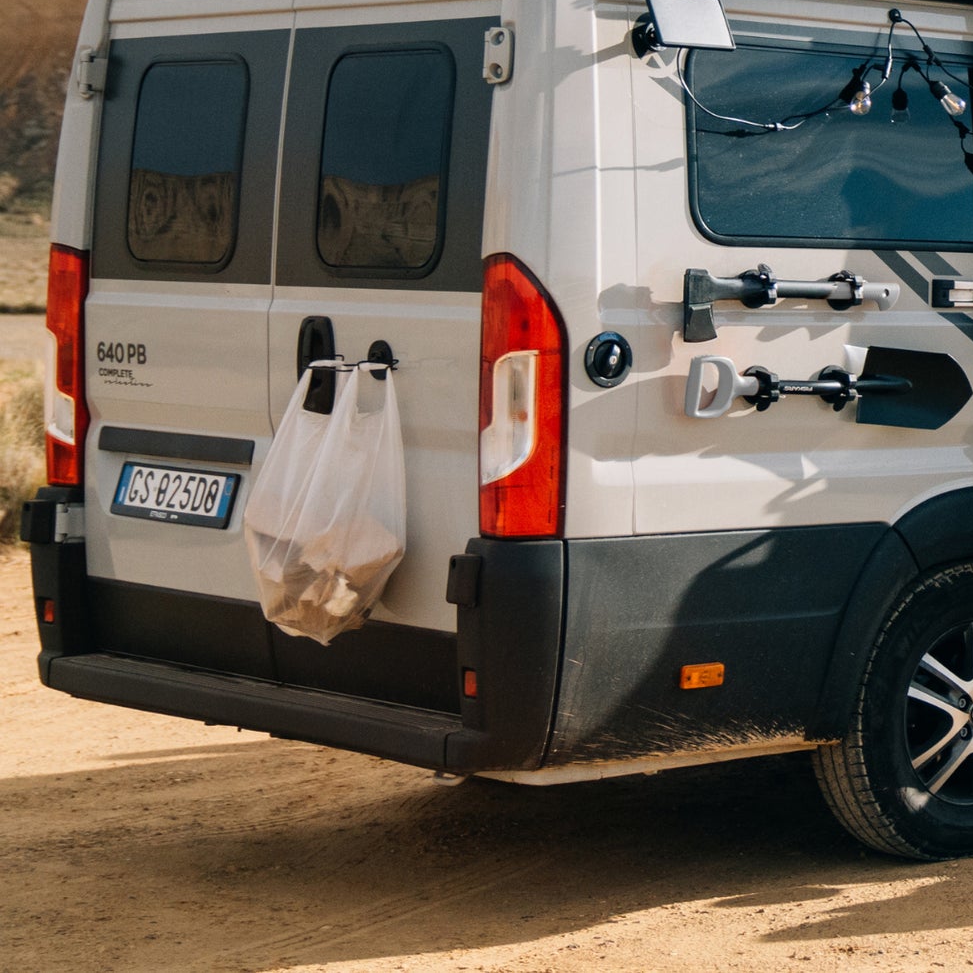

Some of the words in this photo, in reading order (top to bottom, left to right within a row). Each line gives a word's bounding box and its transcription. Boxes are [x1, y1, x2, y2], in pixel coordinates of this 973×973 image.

[97, 341, 124, 363] 640
[127, 343, 147, 364] PB
[99, 368, 134, 378] COMPLETE
